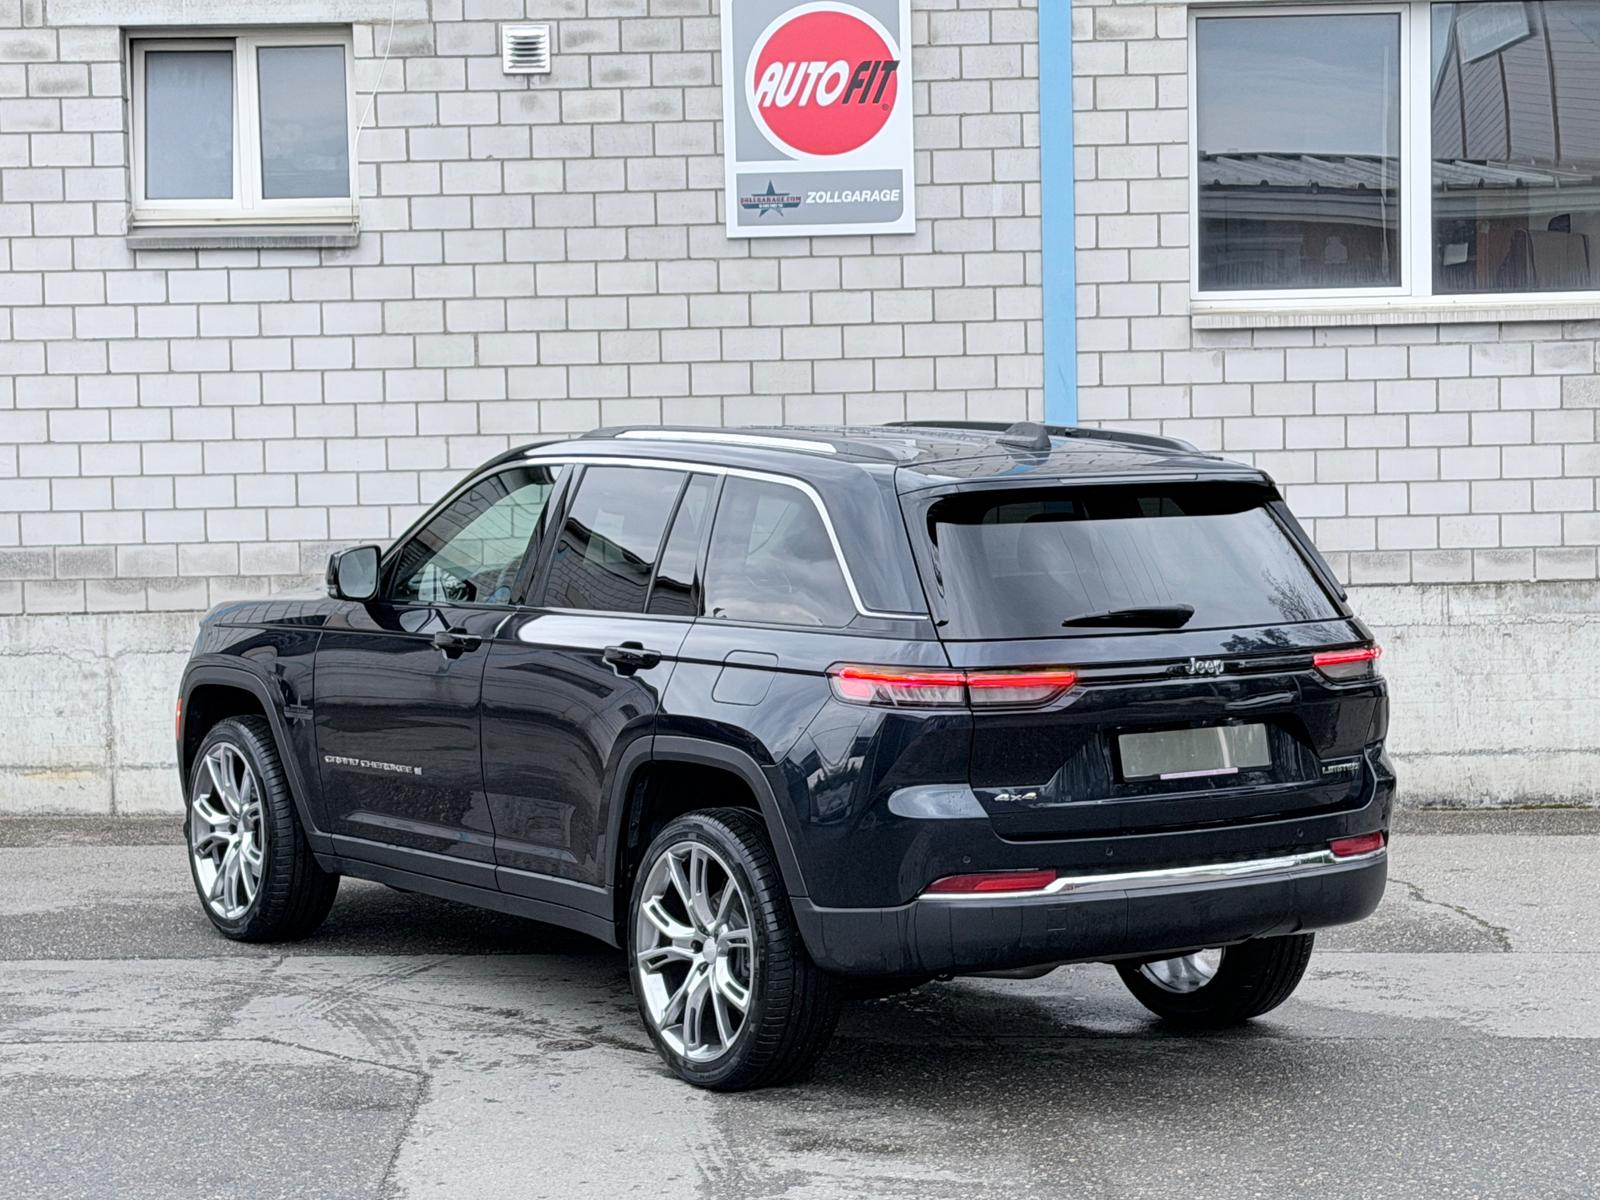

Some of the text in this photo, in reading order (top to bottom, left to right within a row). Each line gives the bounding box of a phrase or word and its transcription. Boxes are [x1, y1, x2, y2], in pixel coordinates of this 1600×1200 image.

[754, 60, 900, 107] AUTOFIT
[806, 189, 900, 204] ZOLLGARAGE
[1185, 657, 1224, 675] Jeep
